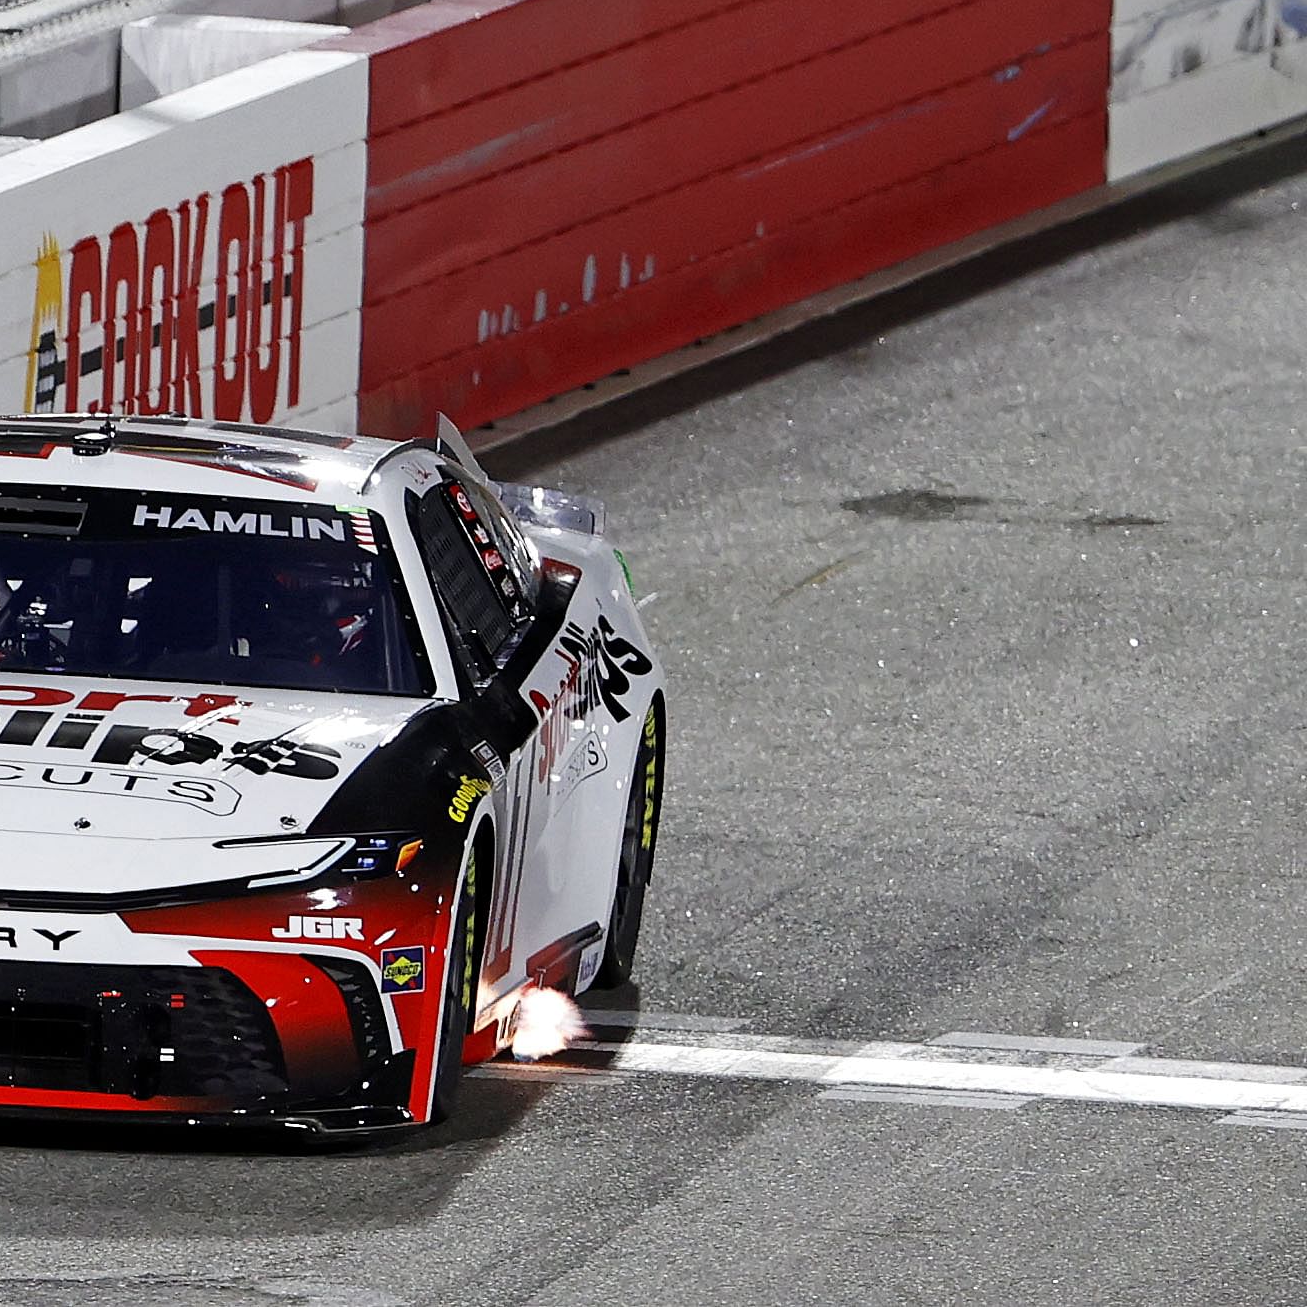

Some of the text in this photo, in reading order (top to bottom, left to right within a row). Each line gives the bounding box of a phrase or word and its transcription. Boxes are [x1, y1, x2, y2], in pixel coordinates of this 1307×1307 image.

[66, 155, 314, 425] COOK OUT
[132, 504, 346, 543] HAMLIN
[272, 915, 365, 941] JGR
[384, 959, 423, 979] SUNOCO
